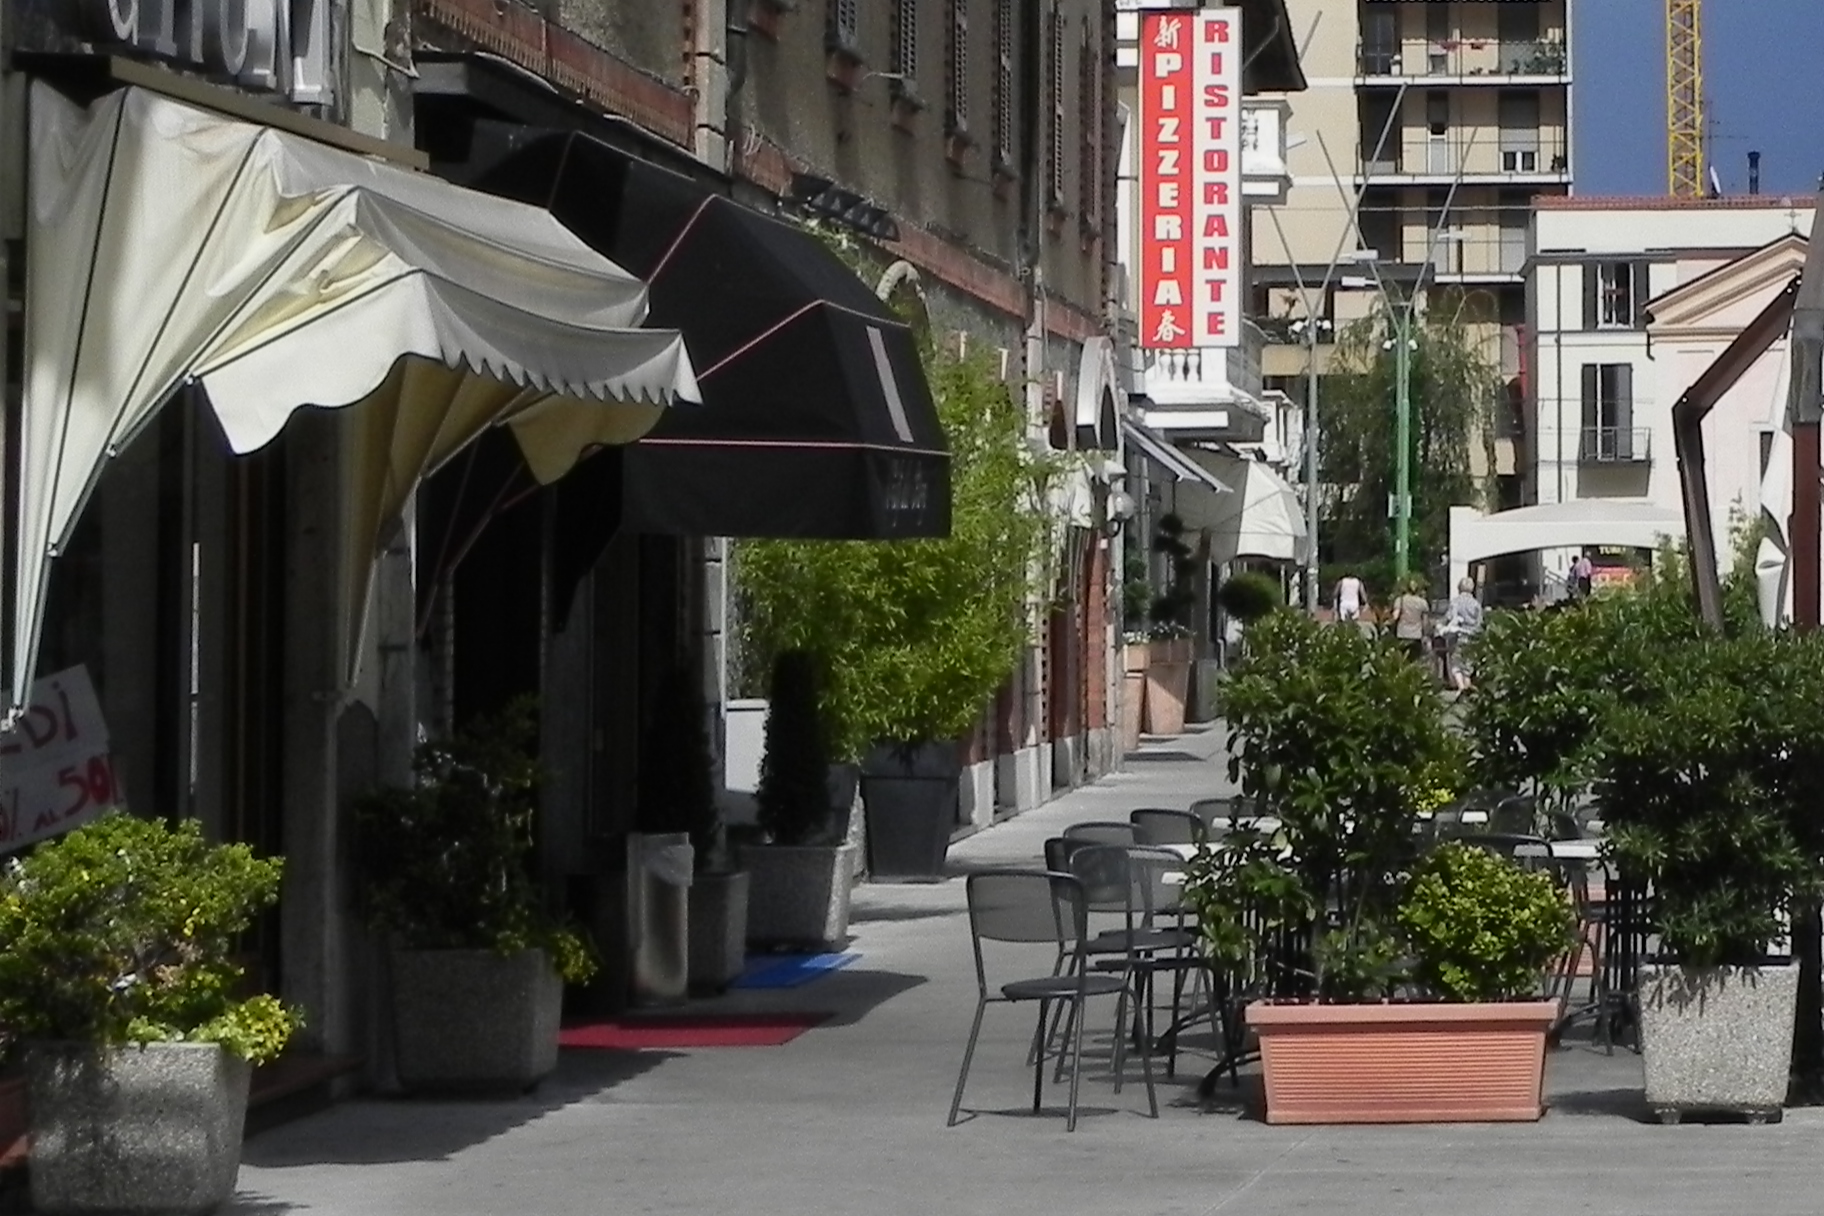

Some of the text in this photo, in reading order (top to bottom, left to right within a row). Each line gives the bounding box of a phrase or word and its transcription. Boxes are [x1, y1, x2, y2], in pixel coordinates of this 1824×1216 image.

[1154, 52, 1183, 306] PIZZERIA
[1203, 19, 1229, 335] RISTORANTE
[1152, 308, 1186, 342] 春
